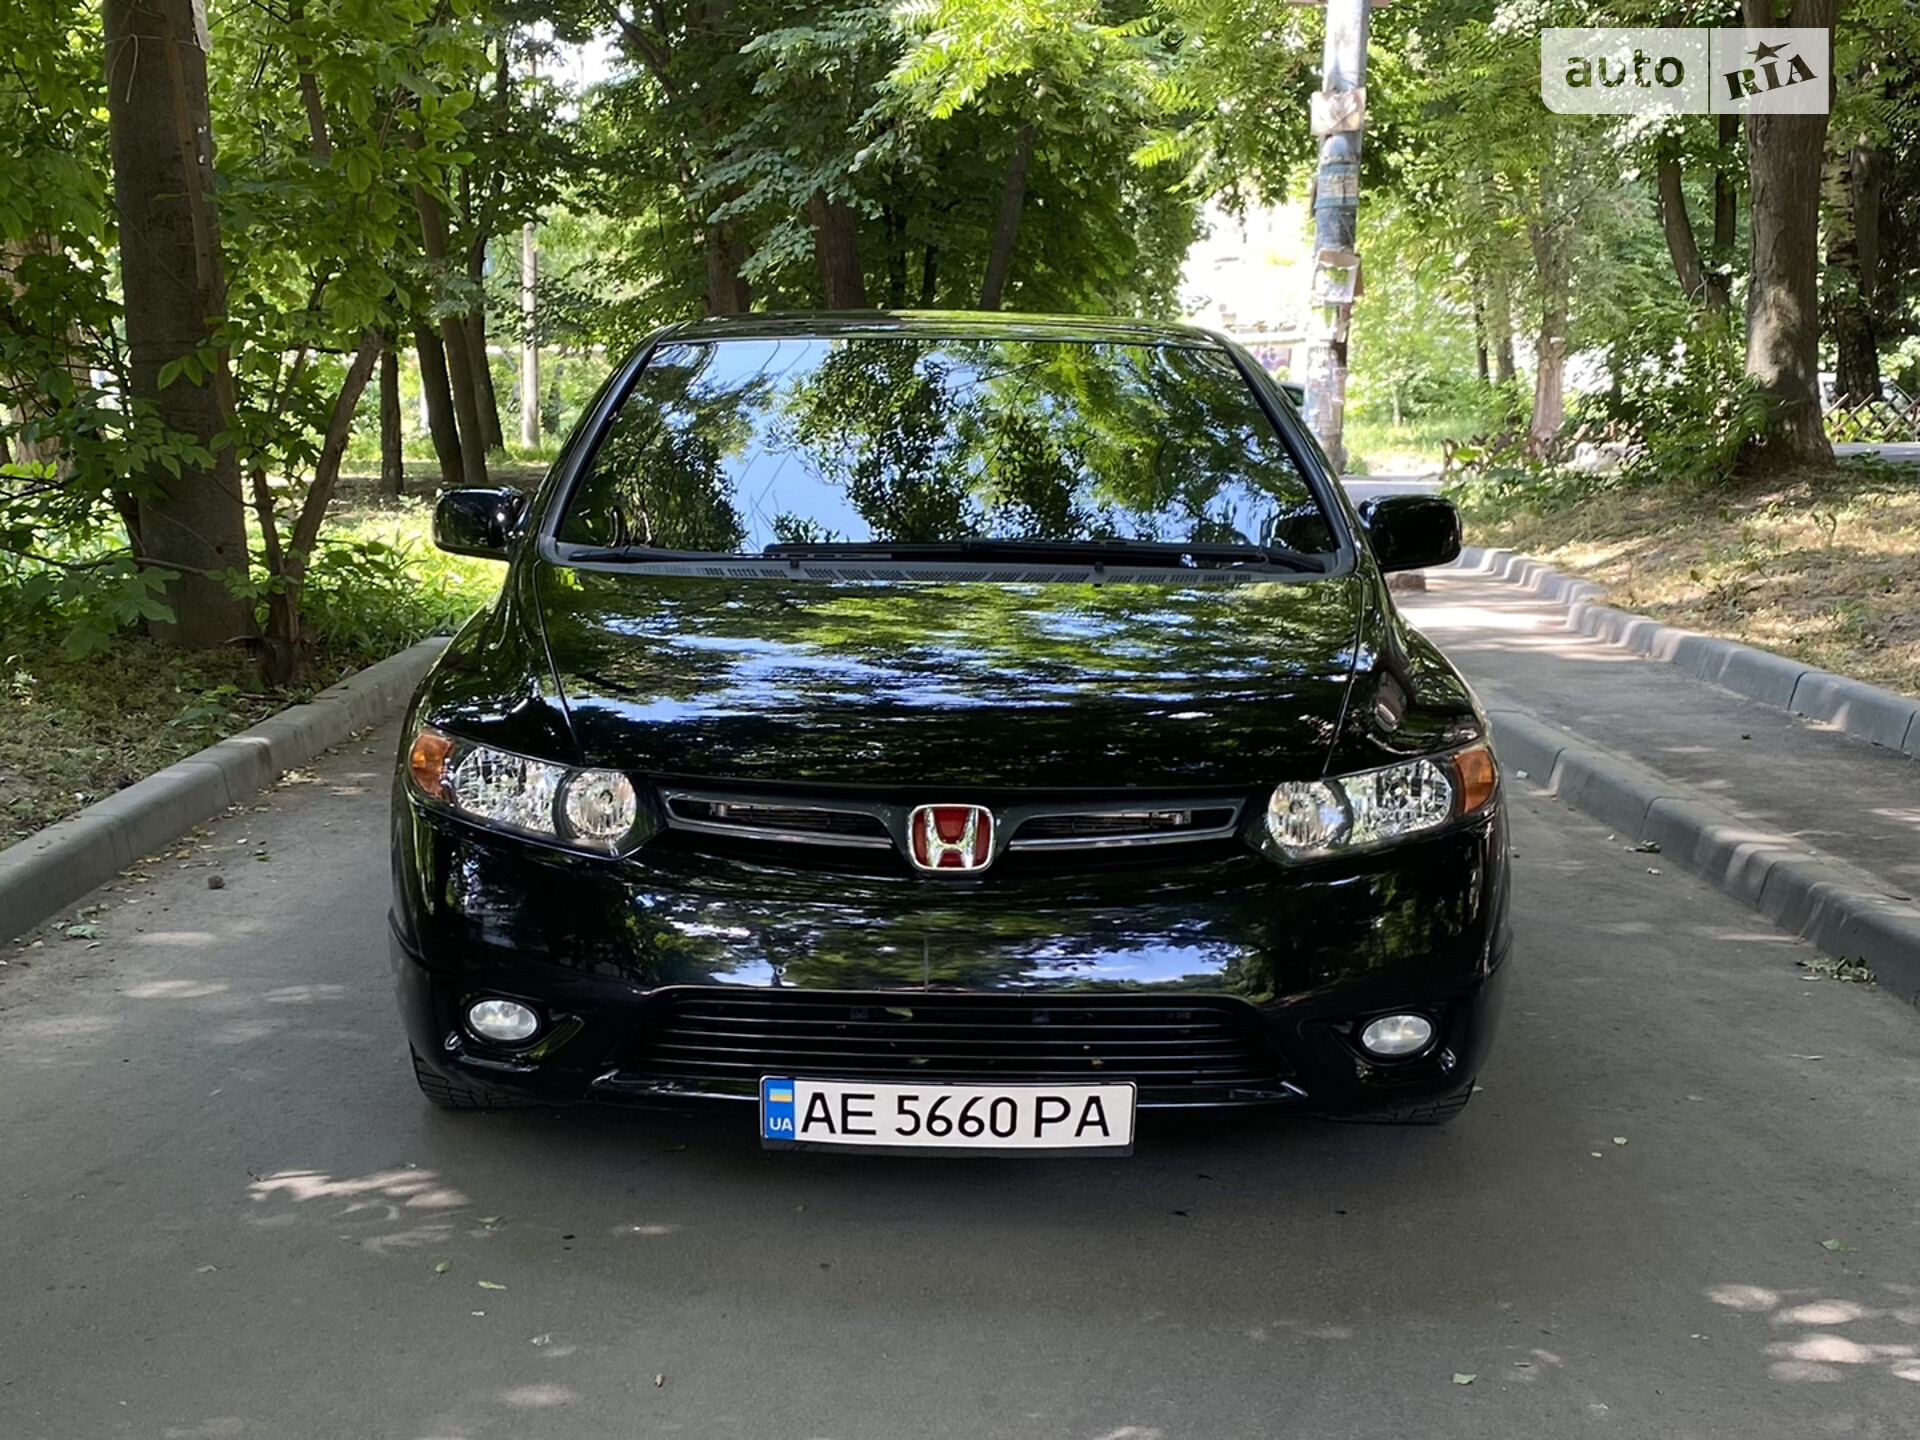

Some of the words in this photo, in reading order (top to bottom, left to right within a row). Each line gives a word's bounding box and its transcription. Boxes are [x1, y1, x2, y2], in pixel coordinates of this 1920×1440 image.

[769, 1117, 793, 1131] UA
[801, 1092, 876, 1135] AE
[895, 1095, 1017, 1137] 5660
[1034, 1096, 1110, 1138] PA
